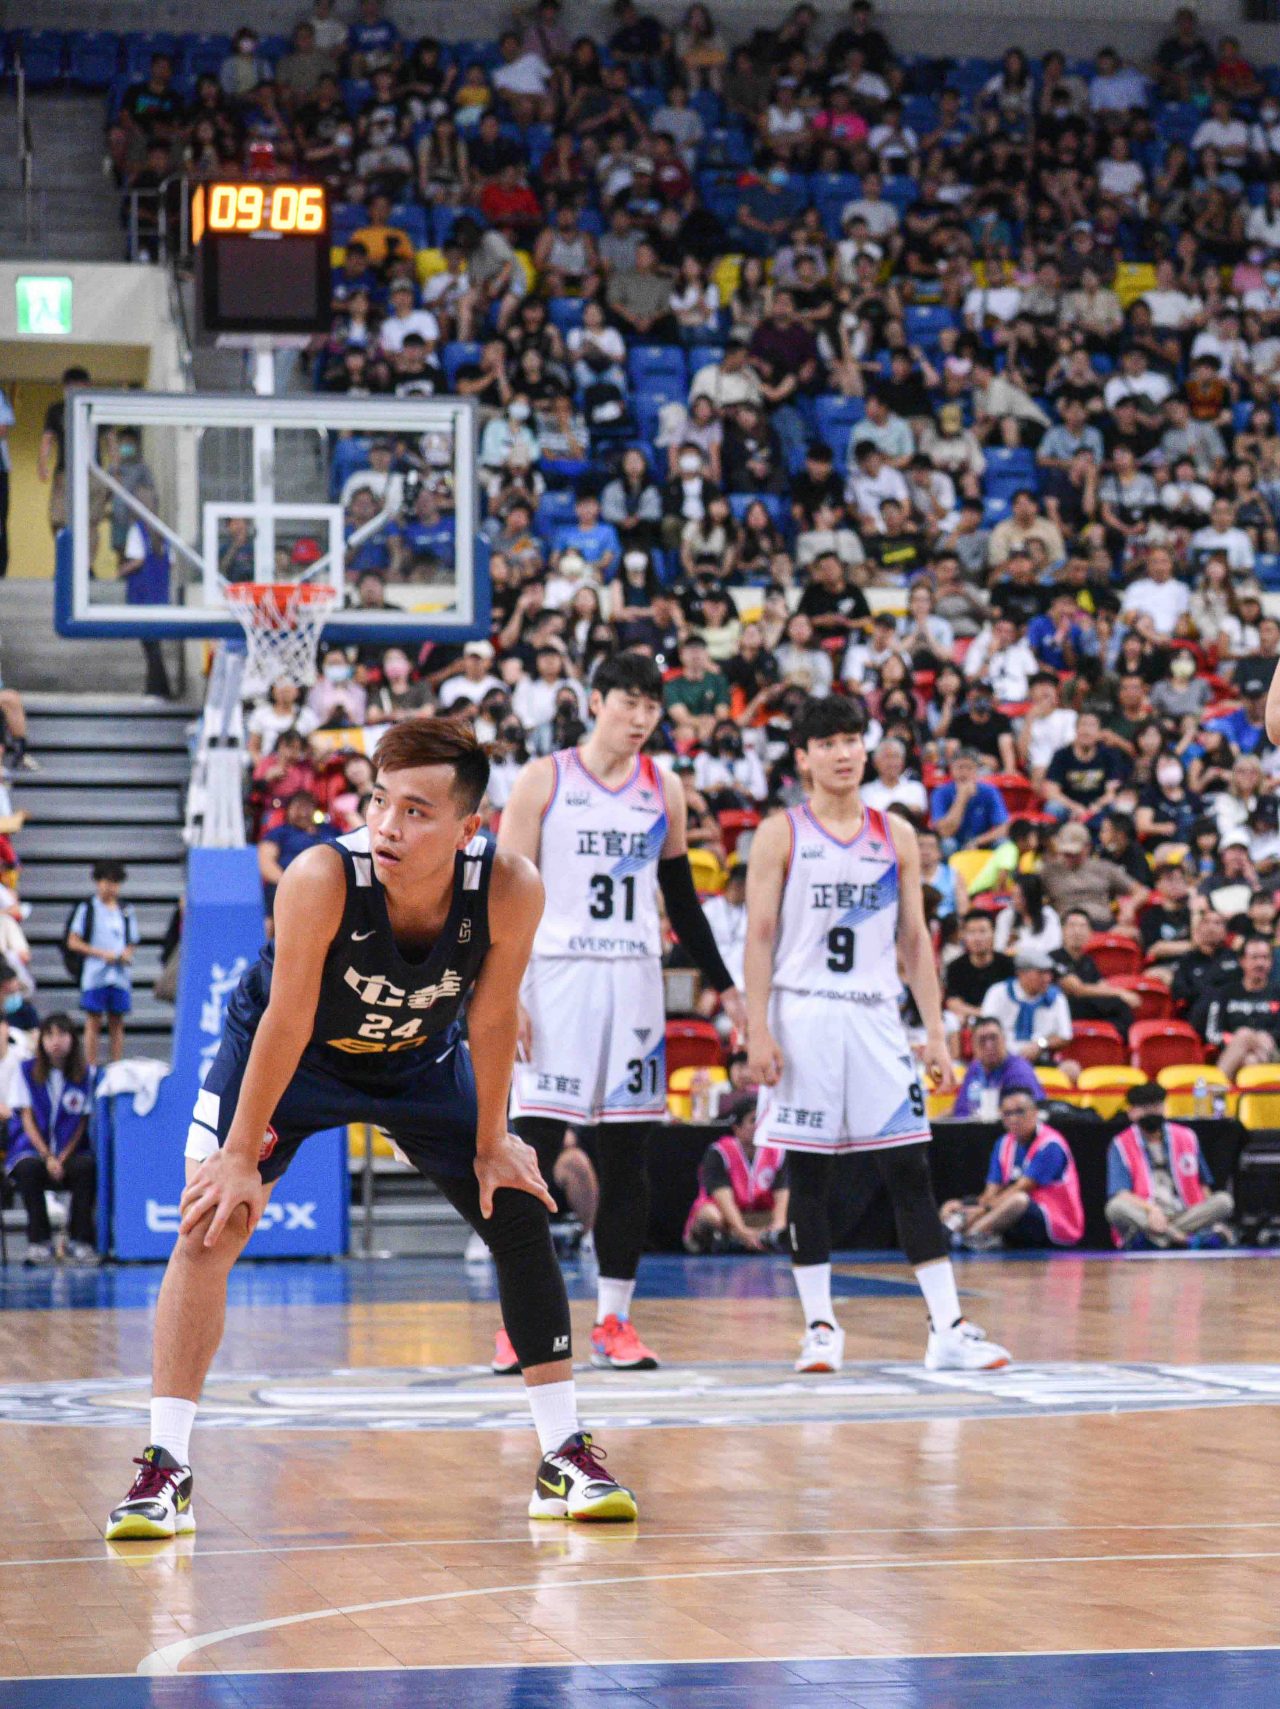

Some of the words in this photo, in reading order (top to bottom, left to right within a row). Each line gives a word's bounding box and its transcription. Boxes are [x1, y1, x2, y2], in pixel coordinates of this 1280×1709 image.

[589, 873, 635, 922] 31
[827, 927, 855, 973] 9
[357, 1013, 423, 1040] 24
[627, 1058, 657, 1095] 31
[908, 1083, 925, 1117] 9
